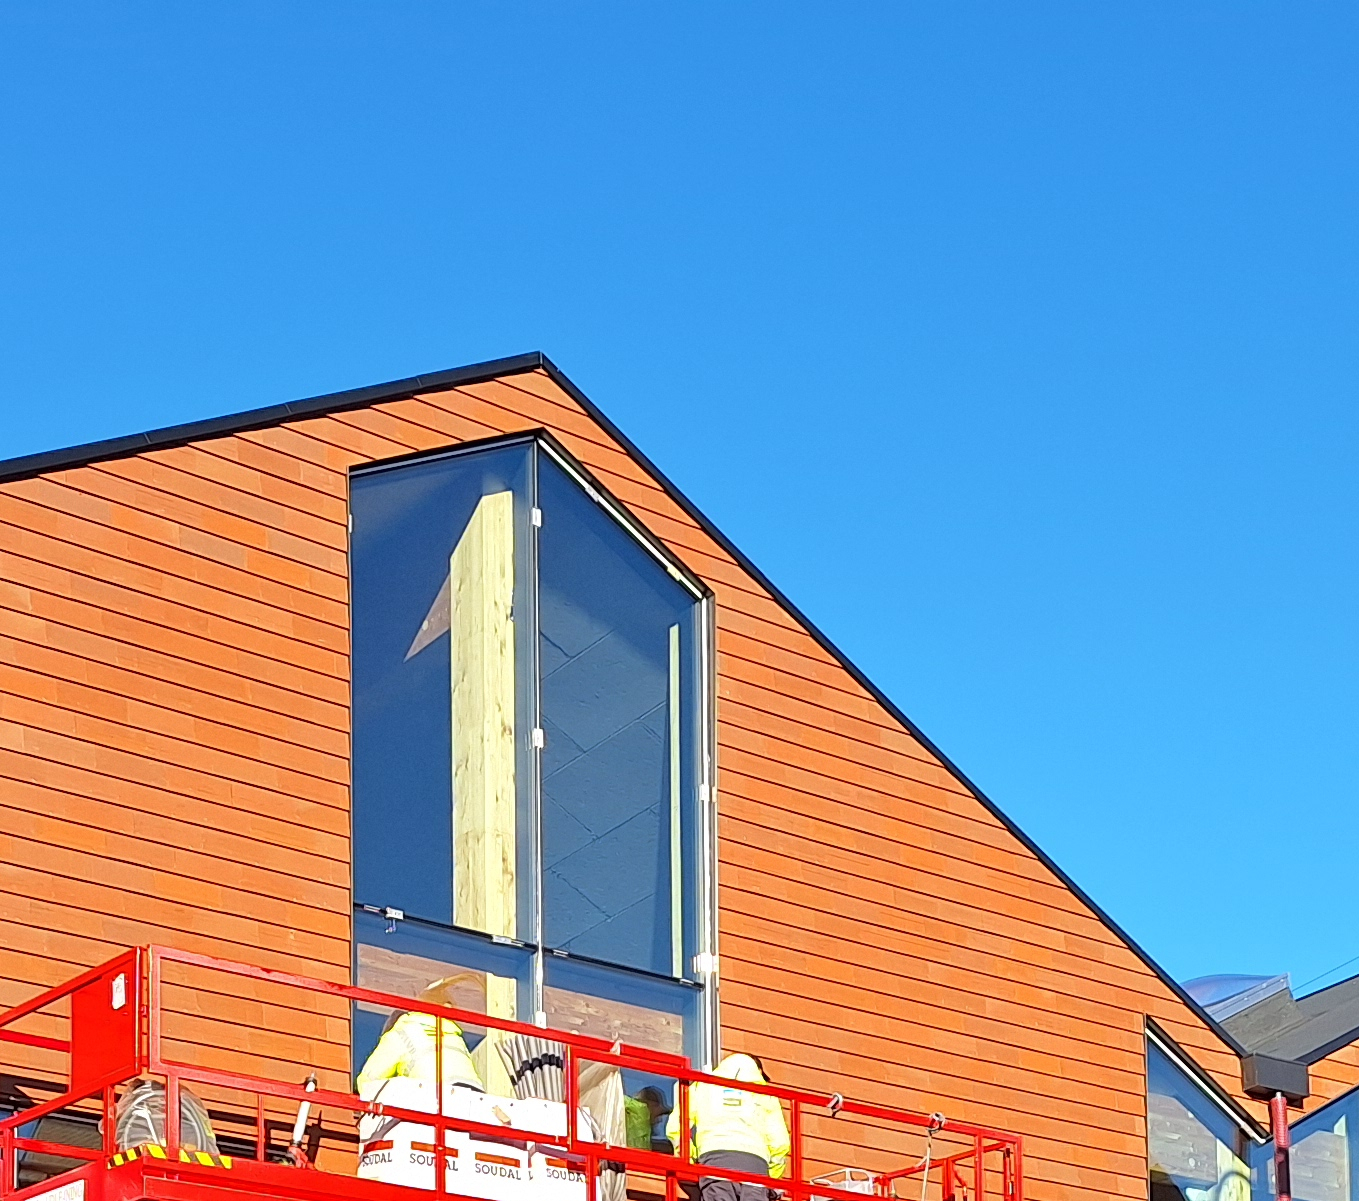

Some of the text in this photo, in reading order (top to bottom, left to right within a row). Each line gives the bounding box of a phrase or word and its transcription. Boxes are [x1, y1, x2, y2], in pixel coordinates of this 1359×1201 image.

[410, 1153, 459, 1172] SOUAL
[475, 1163, 522, 1181] SOUDAL
[546, 1168, 588, 1184] SOUDA
